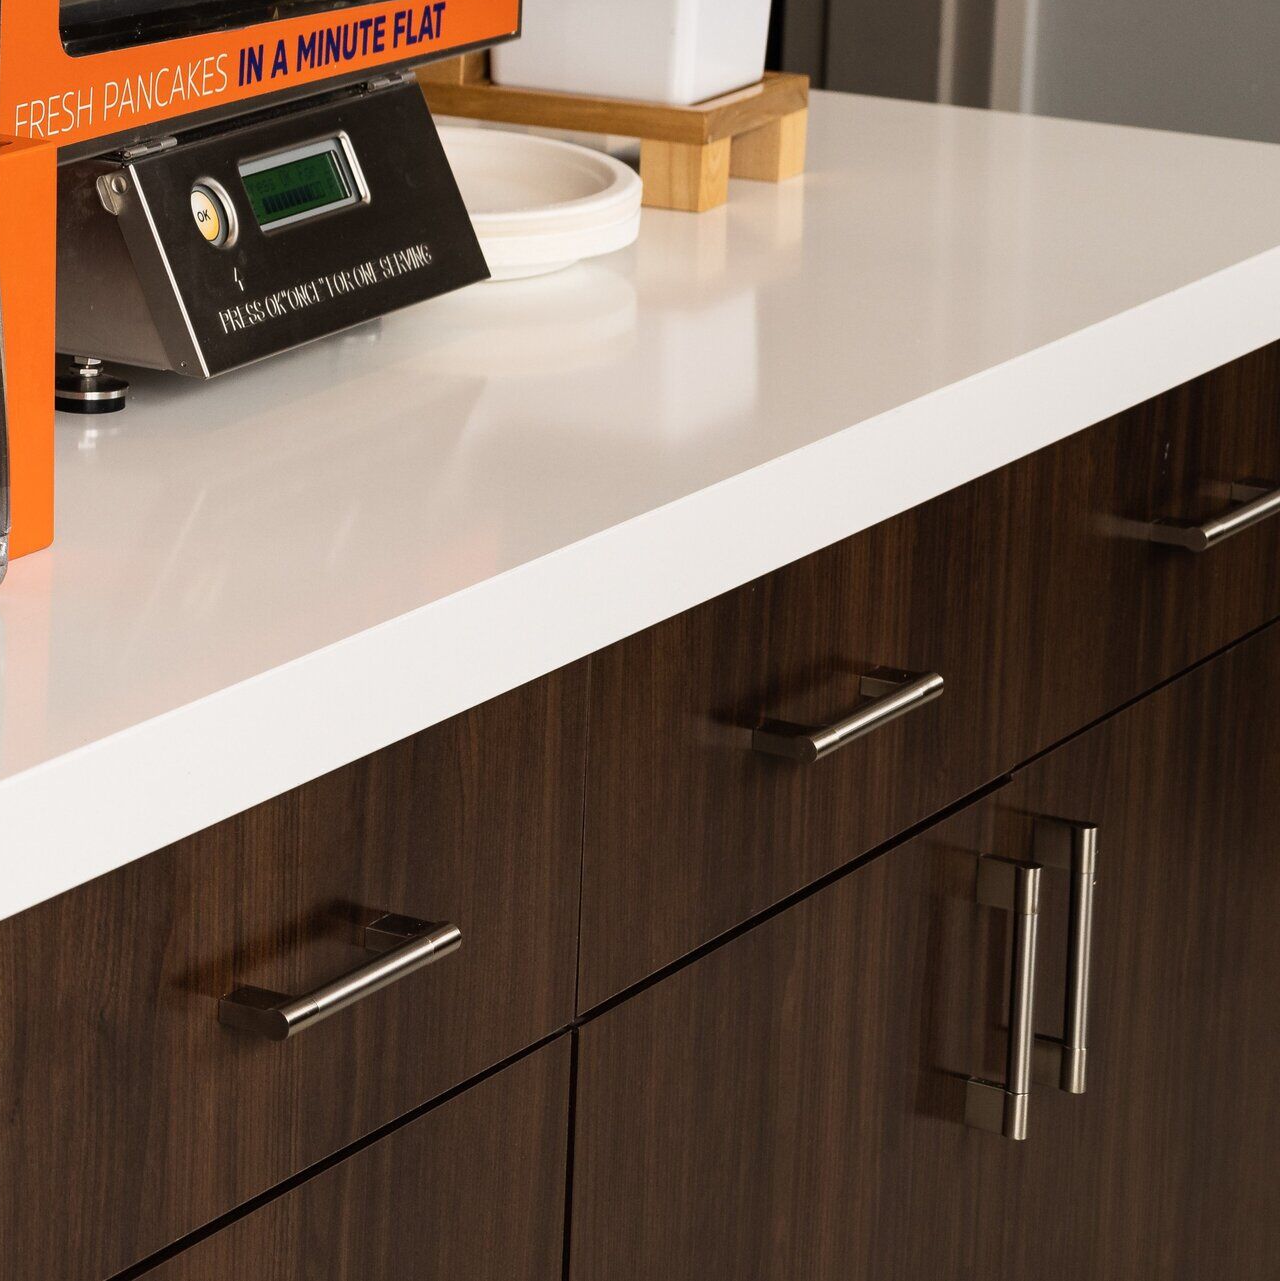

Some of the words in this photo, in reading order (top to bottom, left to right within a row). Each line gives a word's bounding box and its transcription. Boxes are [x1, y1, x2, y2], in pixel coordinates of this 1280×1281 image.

[14, 81, 93, 138] FRESH
[103, 52, 228, 122] PANCAKES
[239, 44, 263, 87] IN
[270, 48, 288, 80] A
[297, 14, 386, 72] MINUTE
[392, 1, 447, 49] FLAT
[197, 209, 212, 223] OK
[218, 298, 267, 336] PRESS
[264, 292, 287, 318] OK
[352, 260, 383, 288] ONE
[378, 243, 433, 280] SERVING
